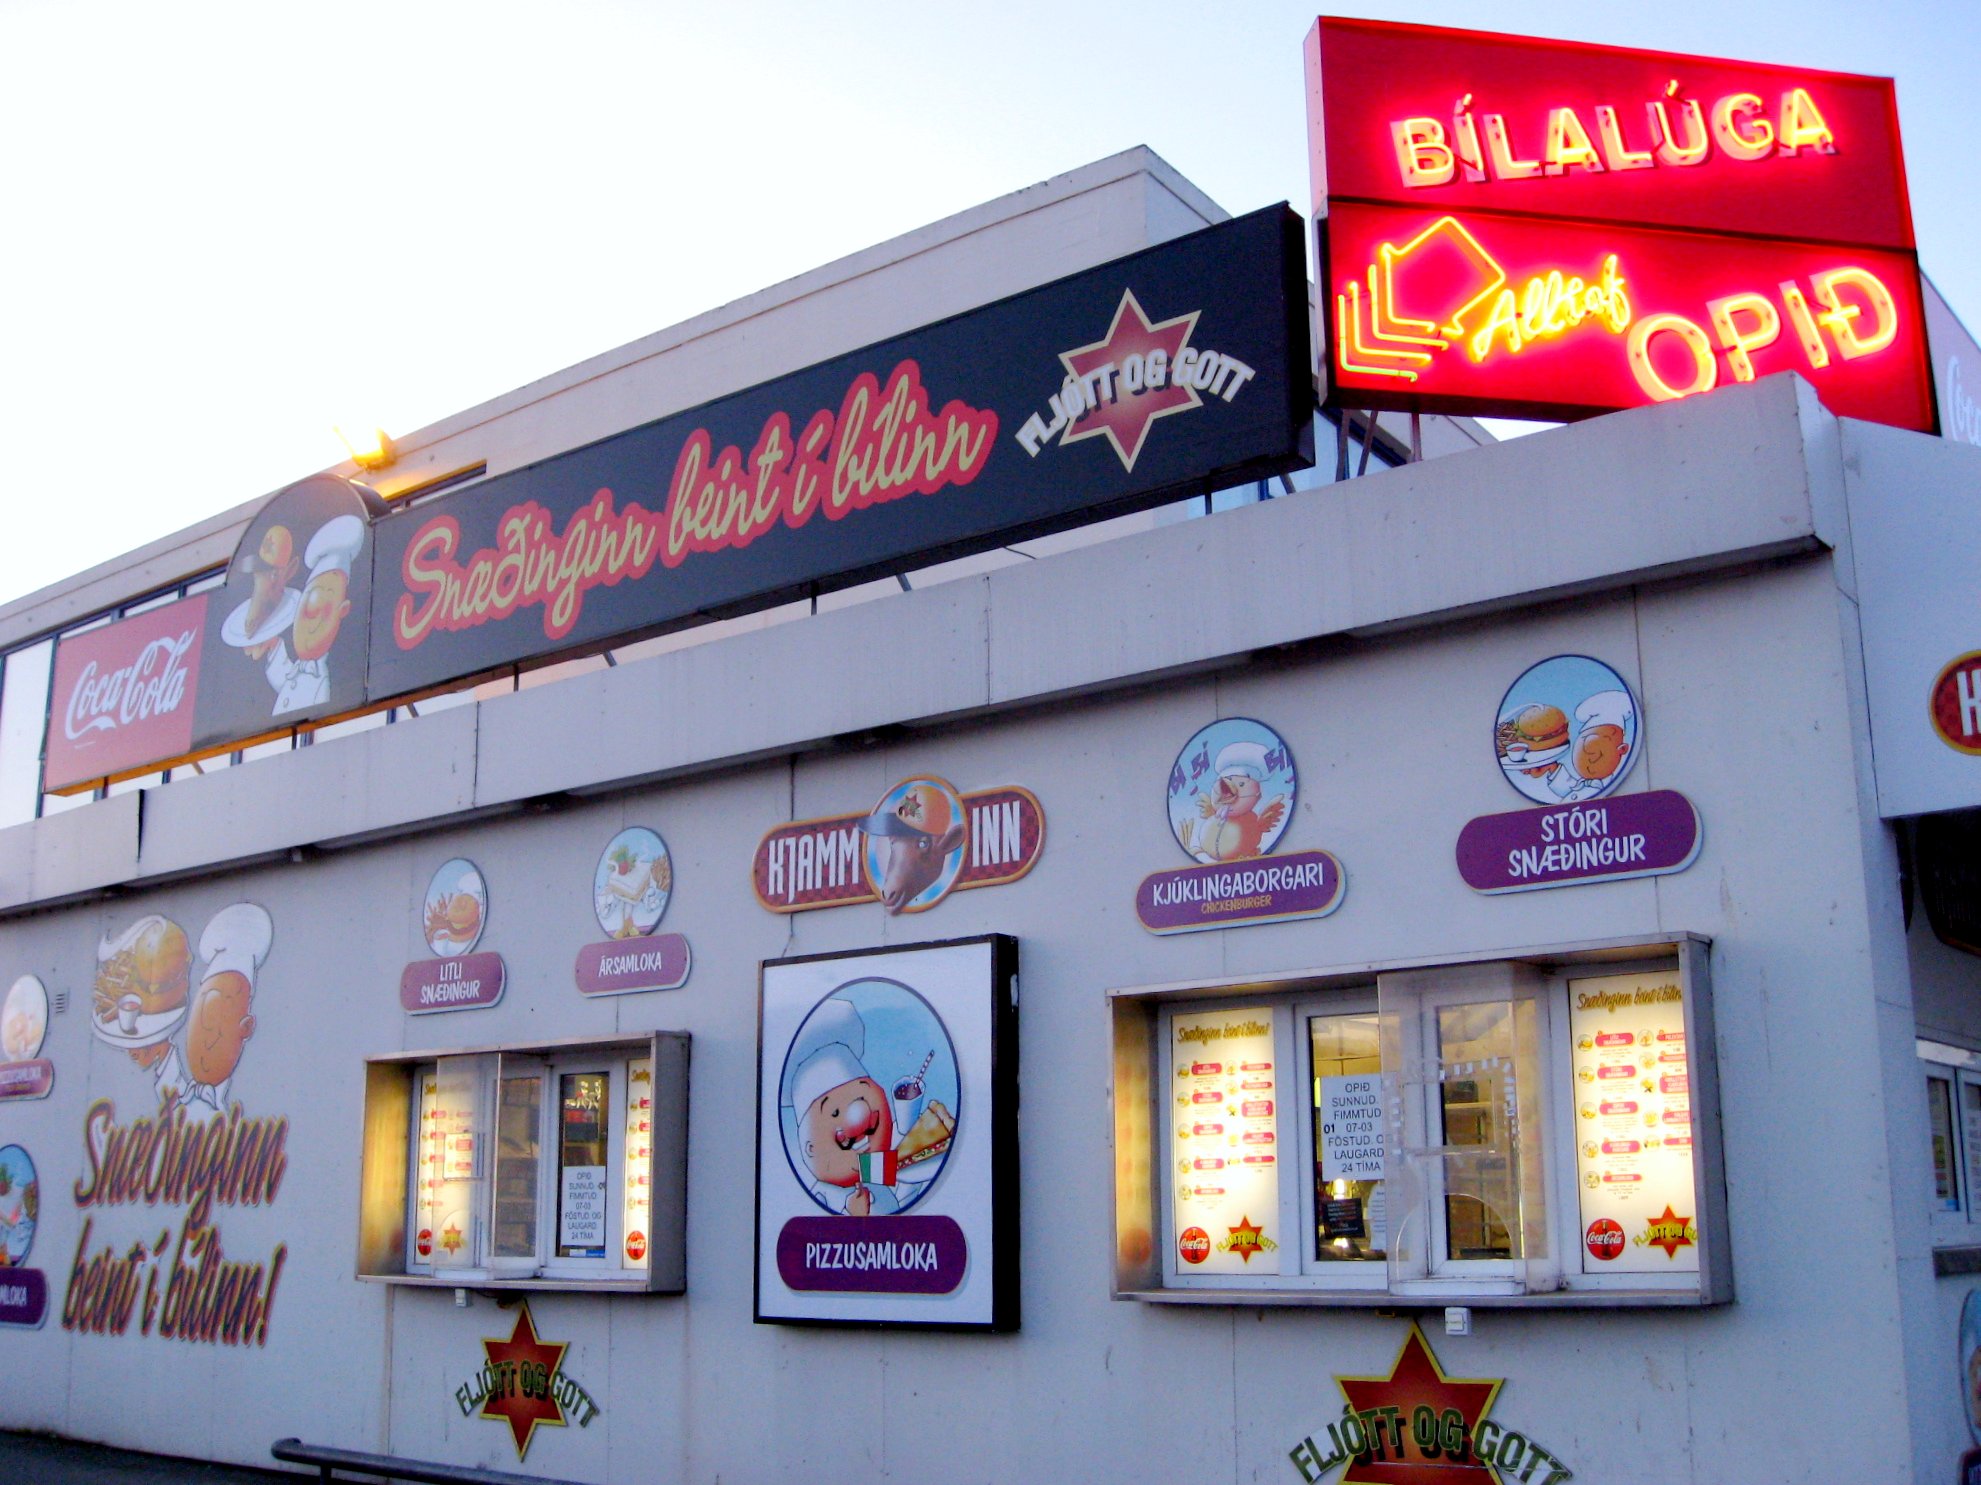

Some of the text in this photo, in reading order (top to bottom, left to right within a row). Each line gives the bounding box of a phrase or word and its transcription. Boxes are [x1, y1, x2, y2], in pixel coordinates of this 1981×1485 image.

[1391, 79, 1840, 188] BÍLALÚGA
[1626, 266, 1898, 402] OPIÐ
[1014, 346, 1257, 459] FLJÓTT OG GOTT
[399, 498, 658, 642] Snæðinginn
[668, 425, 784, 552] beint
[830, 370, 992, 510] bílinn
[65, 624, 198, 740] Coca-Cola
[768, 801, 1021, 904] KJAMM INN
[1540, 806, 1608, 843] STÓRI
[1153, 862, 1324, 906] KJÚKLINGABORGARI
[1508, 833, 1646, 878] SNÆÐINGUR
[1200, 895, 1273, 915] CHICKENBURGER
[439, 961, 463, 982] LITLI
[598, 951, 662, 978] ÁRSAMLOKA
[1345, 1082, 1370, 1093] OPIÐ
[1323, 1122, 1373, 1134] 01 07-03
[74, 1086, 290, 1240] Snæðinginn
[1341, 1162, 1353, 1173] 24
[62, 1215, 146, 1337] beint
[805, 1240, 938, 1271] PIZZUSAMLOKA
[455, 1358, 514, 1418] FLJÓTT
[550, 1370, 600, 1428] GOTT
[1288, 1401, 1573, 1485] FLJÓTT OG GOTT
